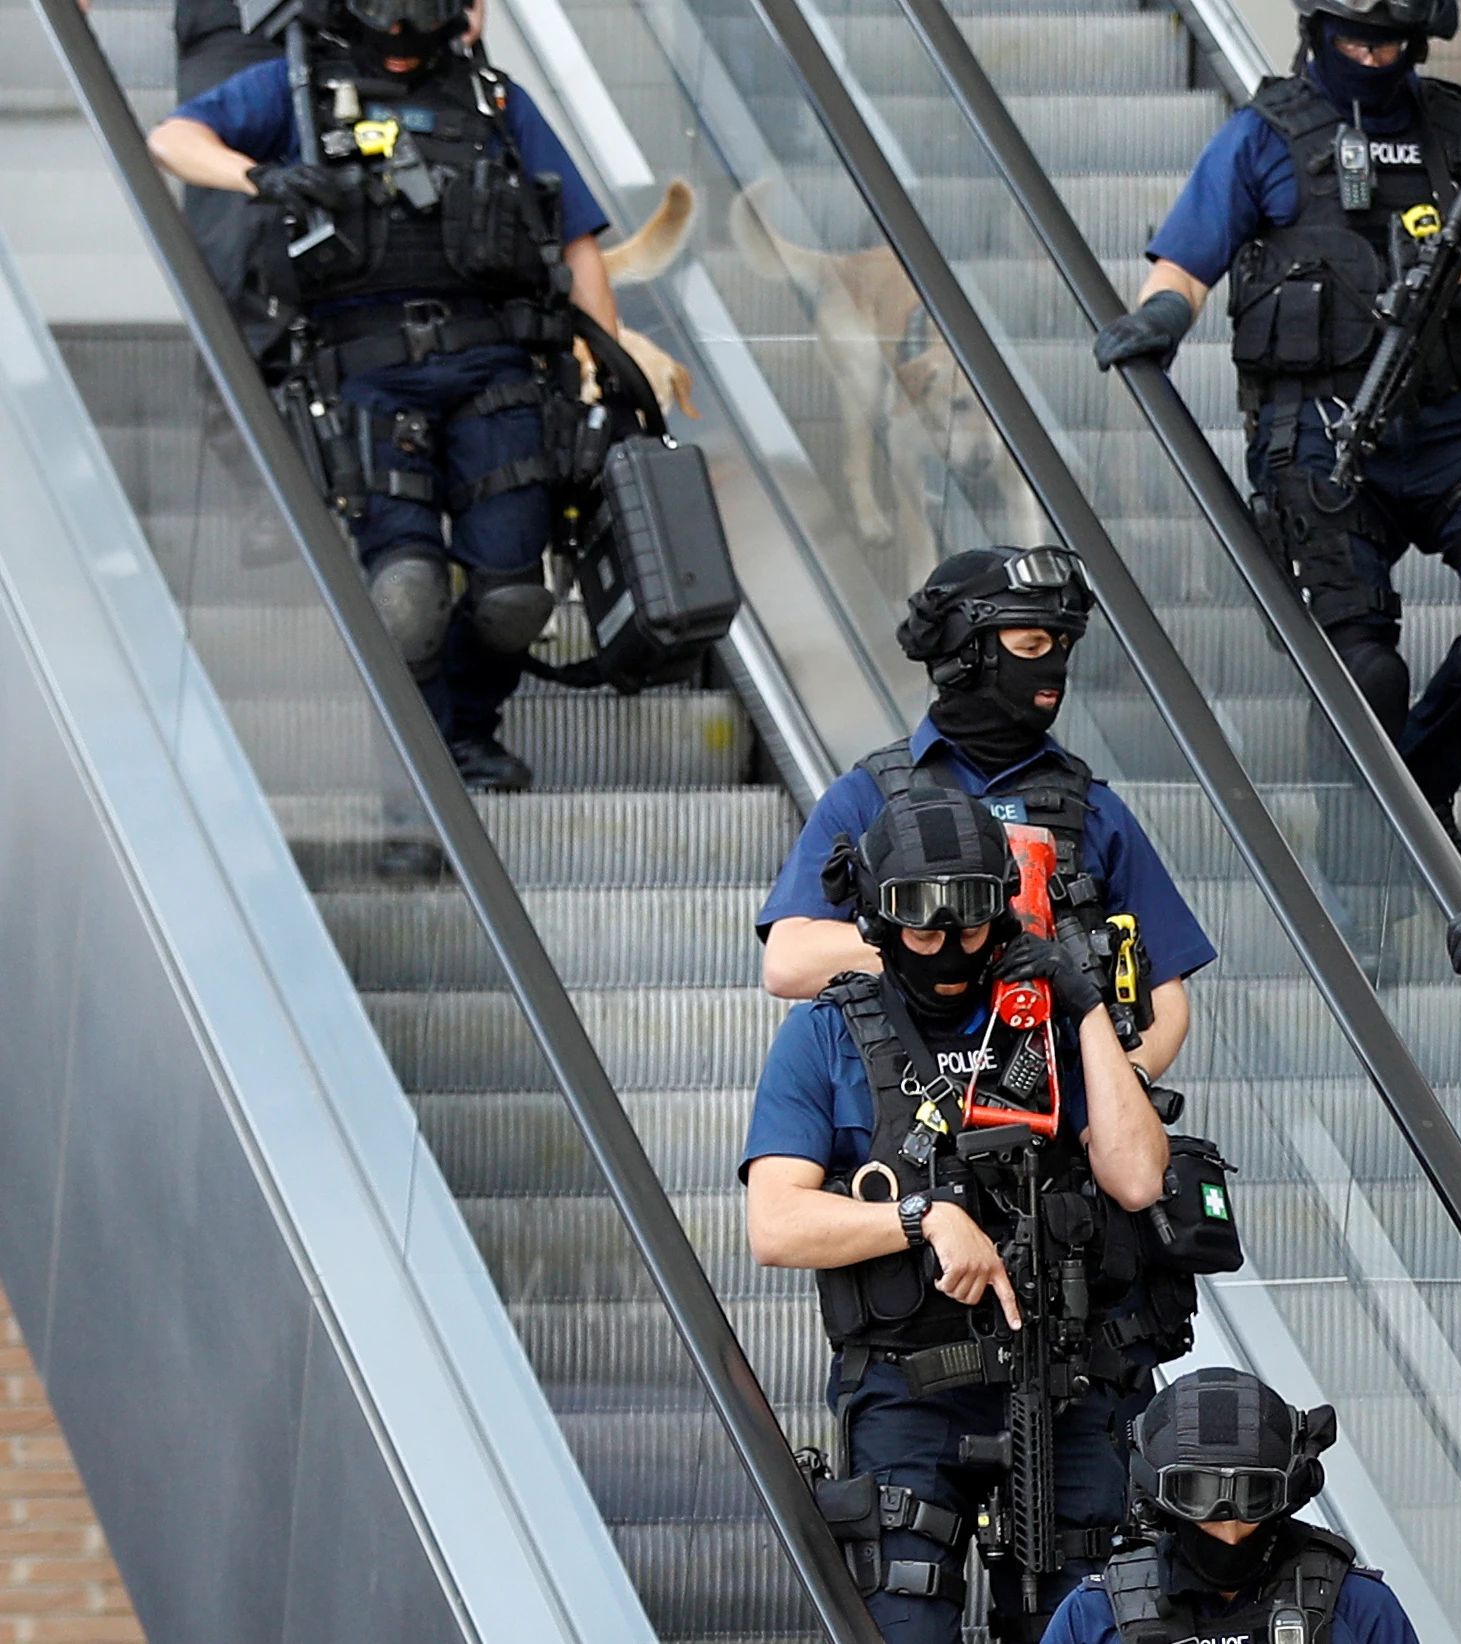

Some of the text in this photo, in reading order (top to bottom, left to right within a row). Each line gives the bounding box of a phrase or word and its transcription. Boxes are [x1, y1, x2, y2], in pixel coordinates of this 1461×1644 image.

[1370, 142, 1422, 164] POLICE
[990, 803, 1018, 821] ICE
[937, 1047, 998, 1075] POLICE
